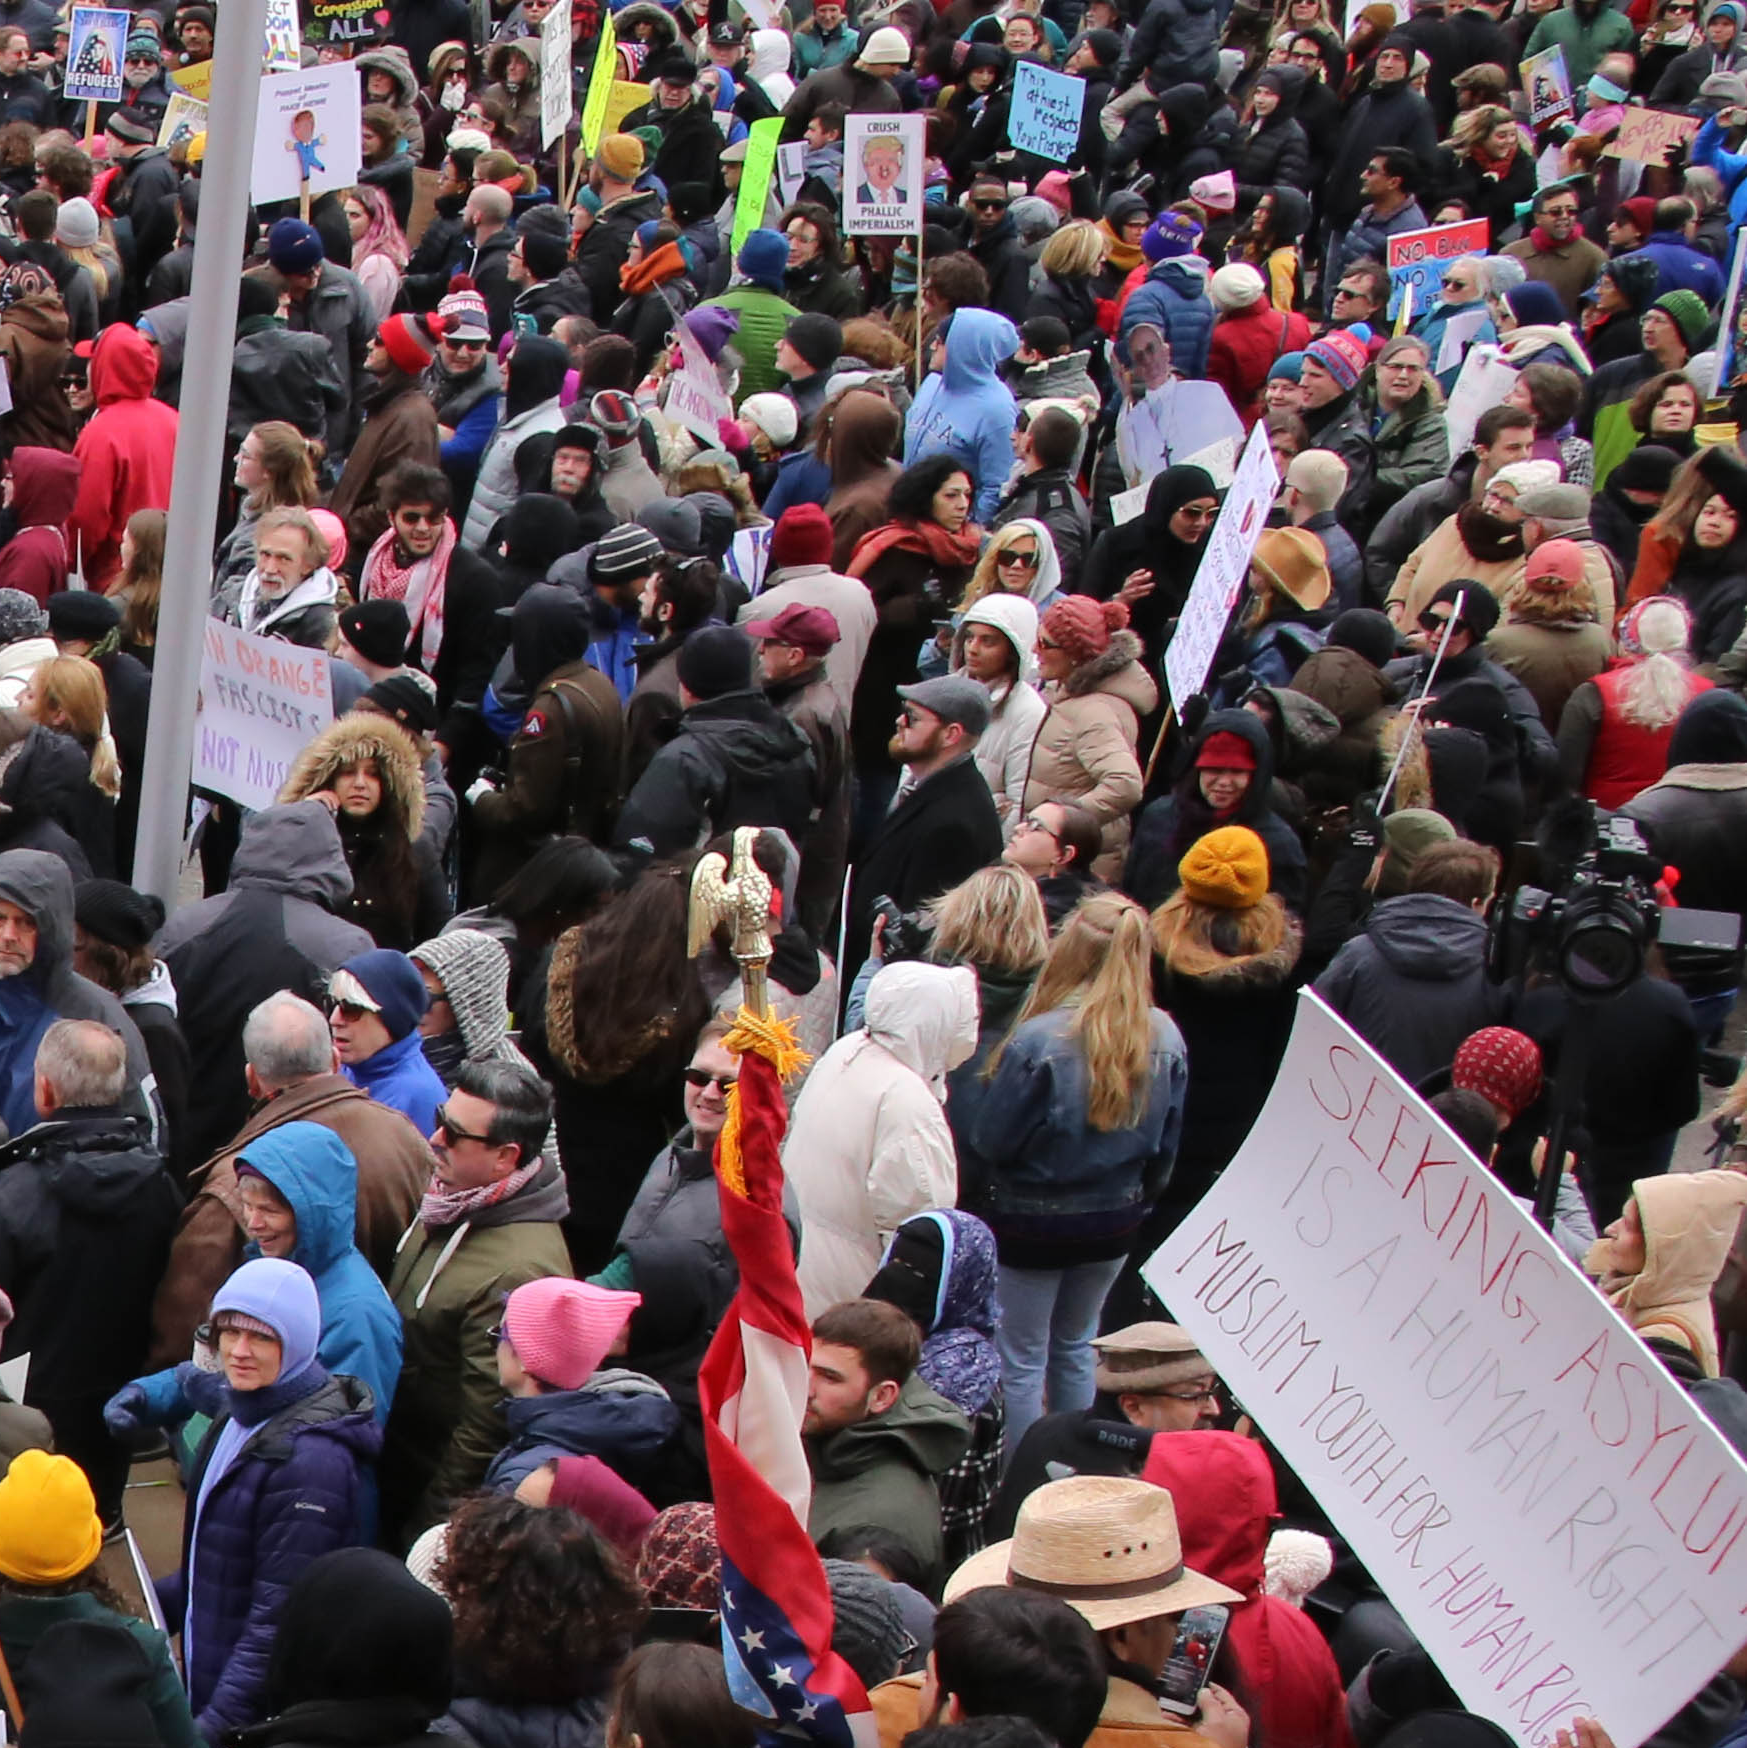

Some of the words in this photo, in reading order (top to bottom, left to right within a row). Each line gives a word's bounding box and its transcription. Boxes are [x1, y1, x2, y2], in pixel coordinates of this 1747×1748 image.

[328, 17, 374, 42] ALL
[67, 72, 122, 89] REFUGEES
[1020, 66, 1046, 86] This
[866, 121, 901, 133] CRUSH
[1033, 107, 1079, 137] respects
[860, 206, 904, 217] PHALLIC
[848, 218, 915, 231] IMPERIALISM
[1394, 239, 1425, 263] NO
[1394, 269, 1425, 290] NO
[236, 638, 328, 699] ORANGE
[200, 726, 241, 777] NOT
[1307, 1043, 1542, 1345] SEEKING
[1280, 1140, 1353, 1250] IS
[1336, 1232, 1403, 1307] A
[1388, 1276, 1578, 1520] HUMAN
[1547, 1483, 1725, 1677] RIGHT
[1174, 1216, 1322, 1396] MUSLIM
[1300, 1364, 1396, 1507] YOUTH
[1376, 1474, 1454, 1570] FOR
[1419, 1545, 1556, 1697] HUMAN
